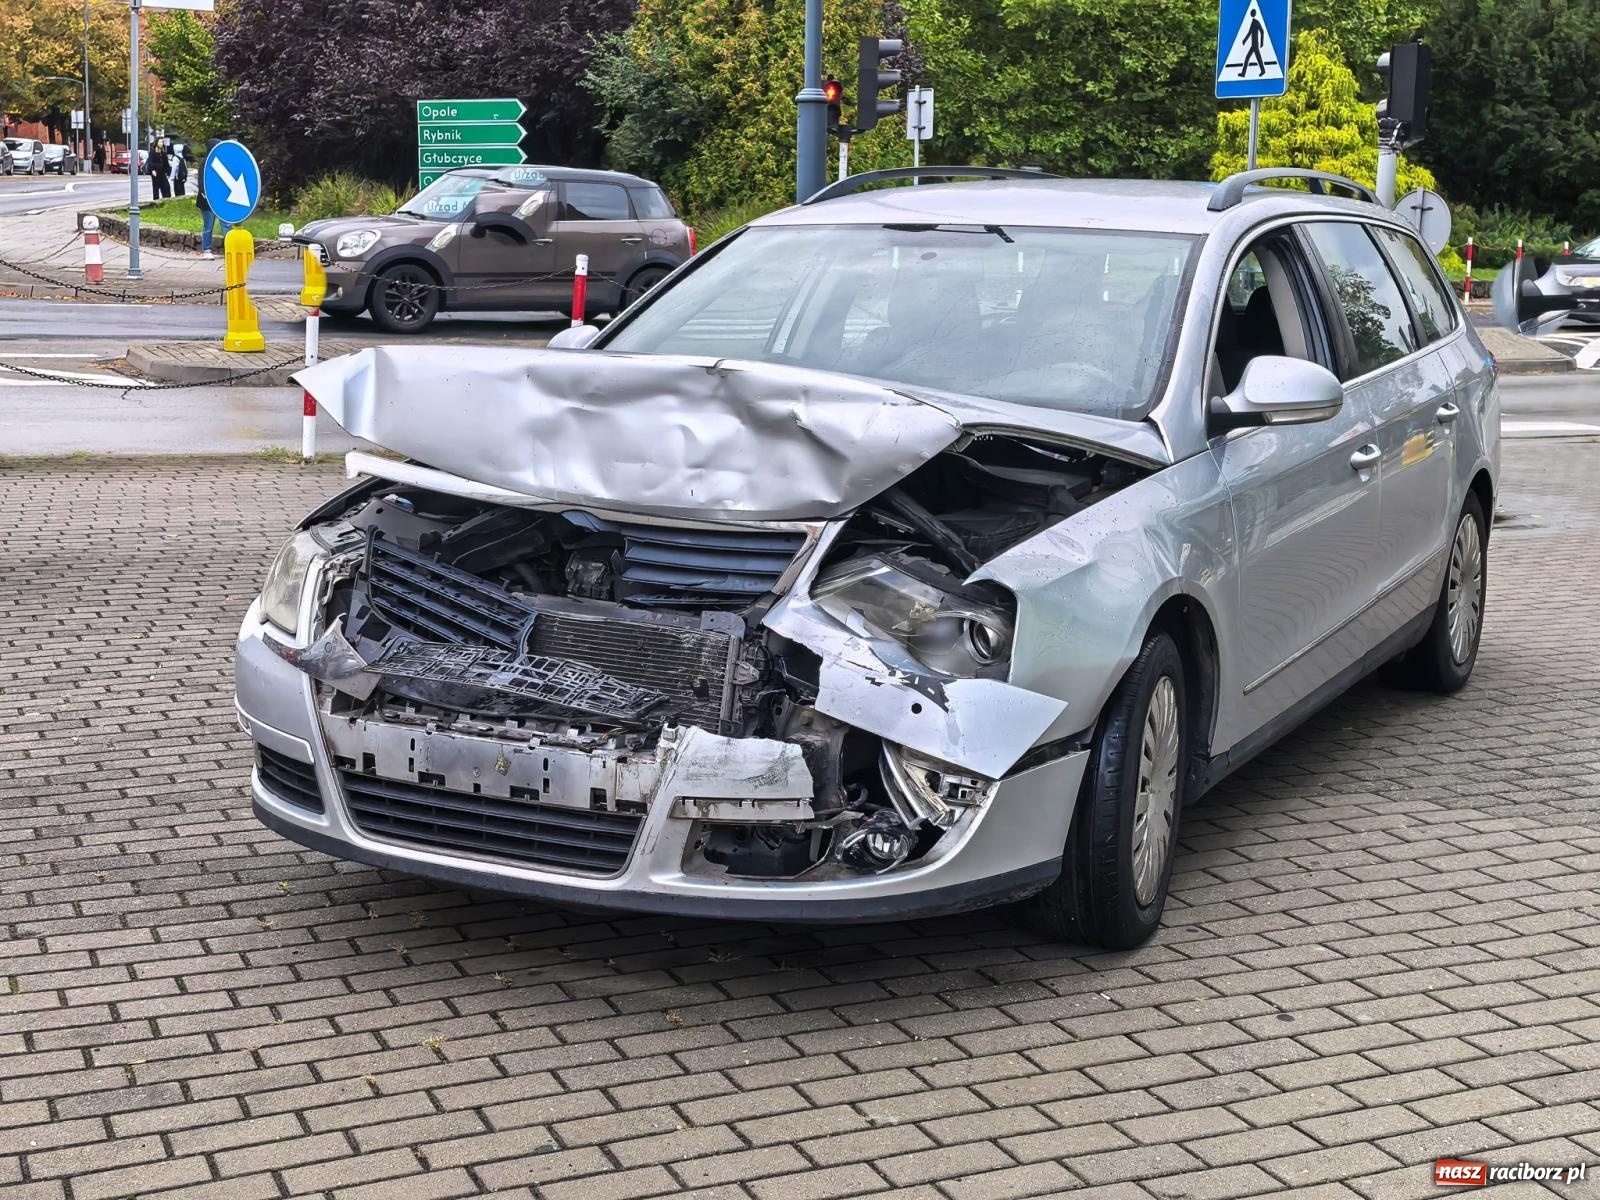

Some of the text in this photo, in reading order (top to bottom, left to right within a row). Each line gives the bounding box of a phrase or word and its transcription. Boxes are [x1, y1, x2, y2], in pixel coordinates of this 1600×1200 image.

[421, 106, 458, 120] Opole
[423, 129, 462, 143] Rybnik
[422, 152, 483, 165] Głubczyce
